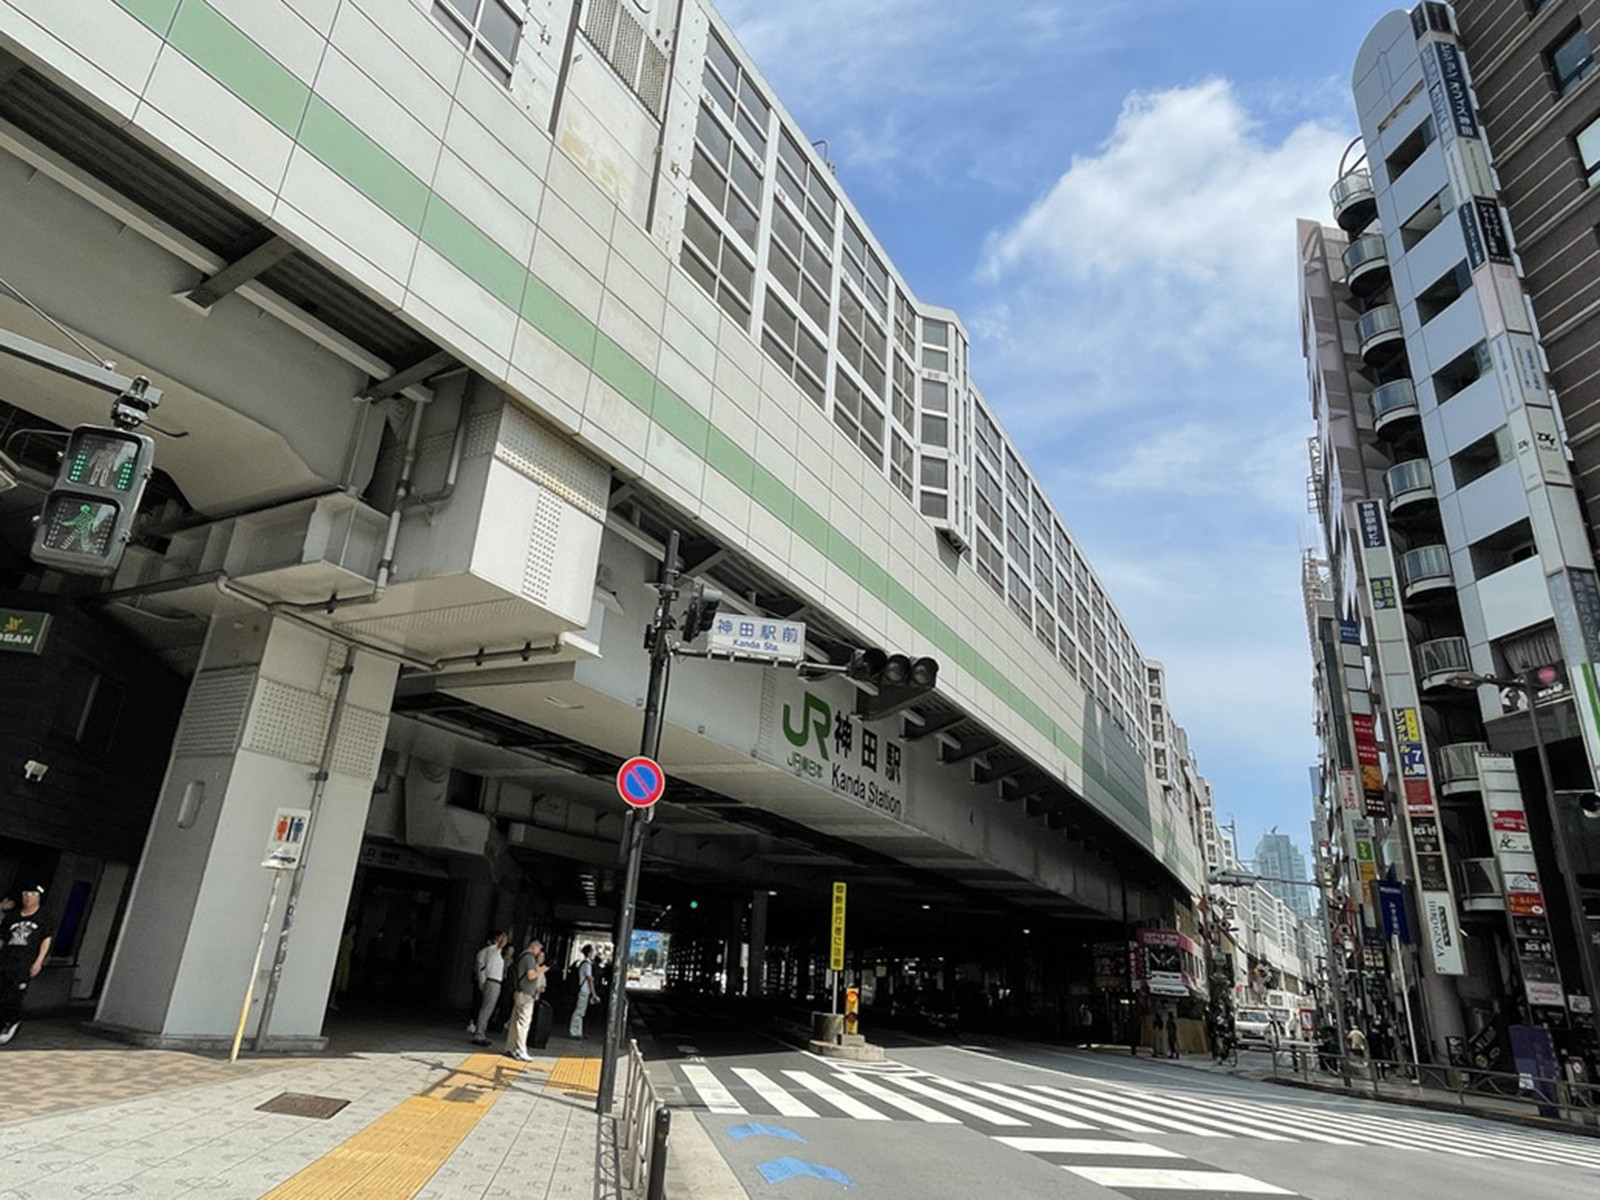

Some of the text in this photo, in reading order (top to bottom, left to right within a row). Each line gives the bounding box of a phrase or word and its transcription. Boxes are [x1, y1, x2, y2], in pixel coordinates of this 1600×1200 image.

[0, 633, 33, 645] BAN
[717, 618, 798, 644] 神田駅前
[732, 638, 761, 650] Kanda
[782, 691, 832, 762] JR
[1394, 709, 1416, 775] レンタルルーム
[787, 751, 824, 779] JR東日本
[834, 710, 902, 785] 神田駅
[831, 762, 903, 815] Kanda Station
